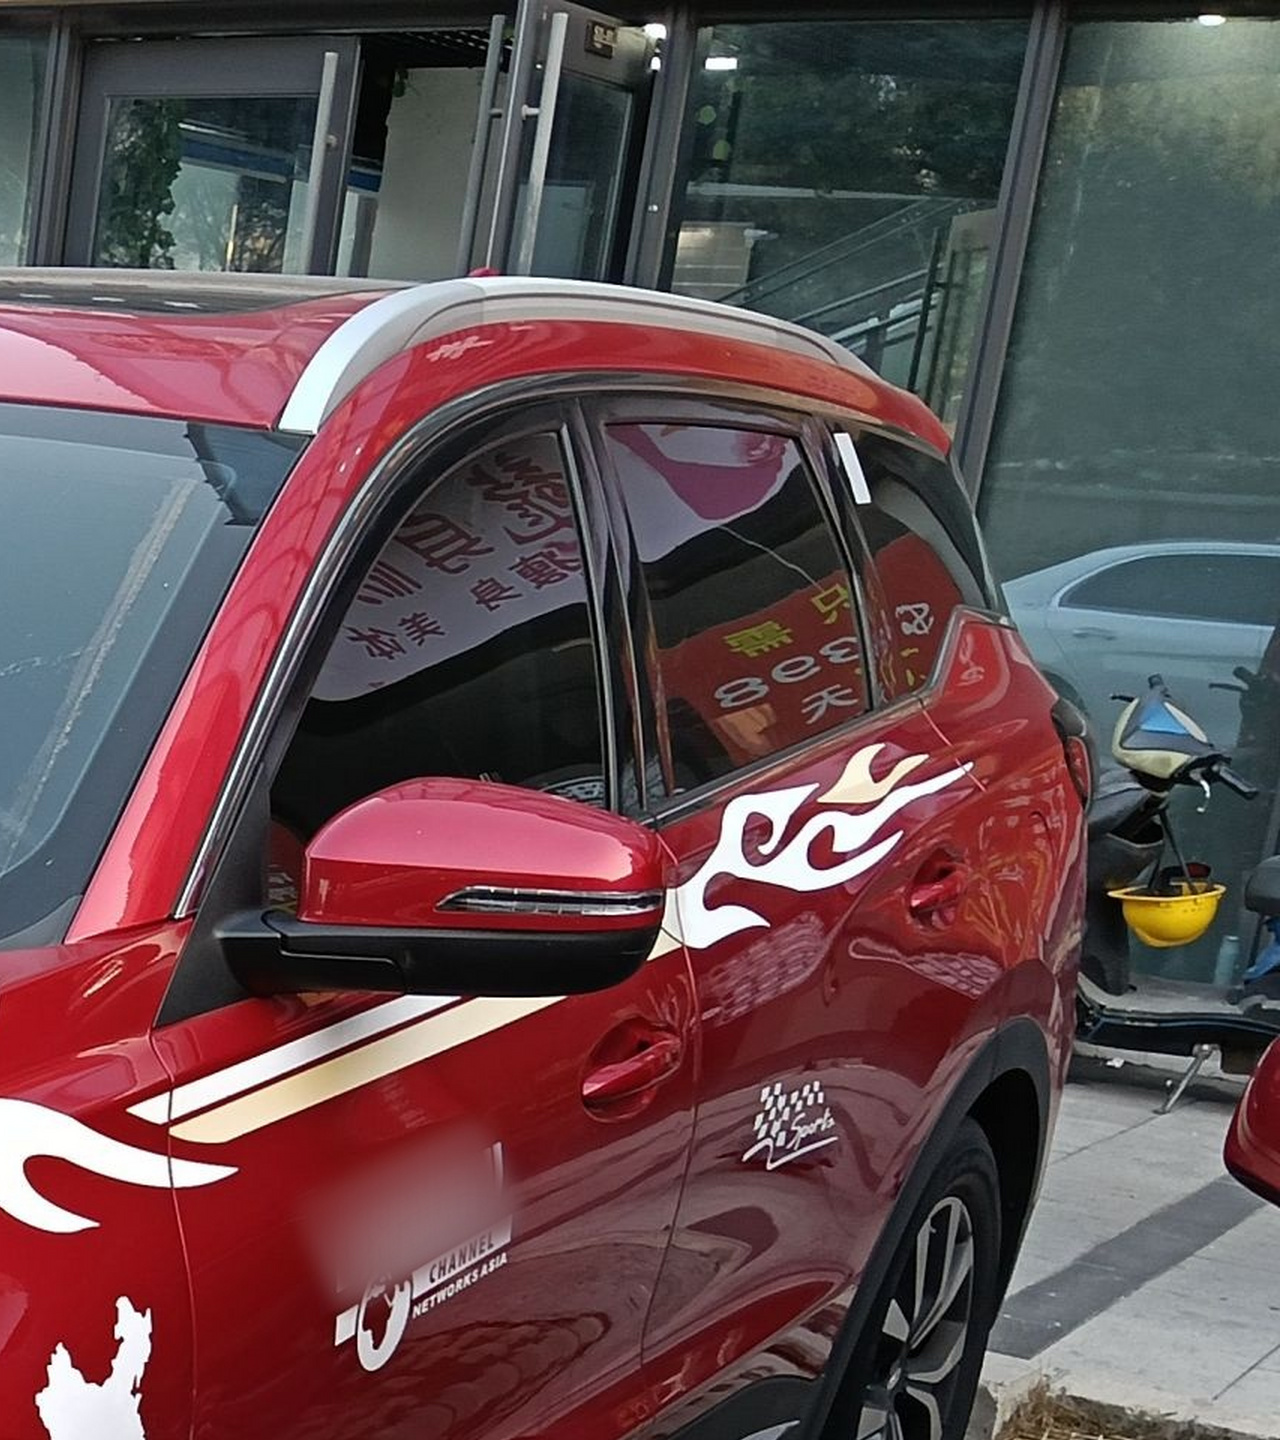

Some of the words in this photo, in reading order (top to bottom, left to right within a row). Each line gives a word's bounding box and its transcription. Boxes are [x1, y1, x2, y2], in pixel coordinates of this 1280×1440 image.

[786, 1107, 836, 1150] Sports
[429, 1232, 494, 1284] CHANNEL
[412, 1269, 479, 1319] NETWORKS
[480, 1252, 508, 1279] ASIA
